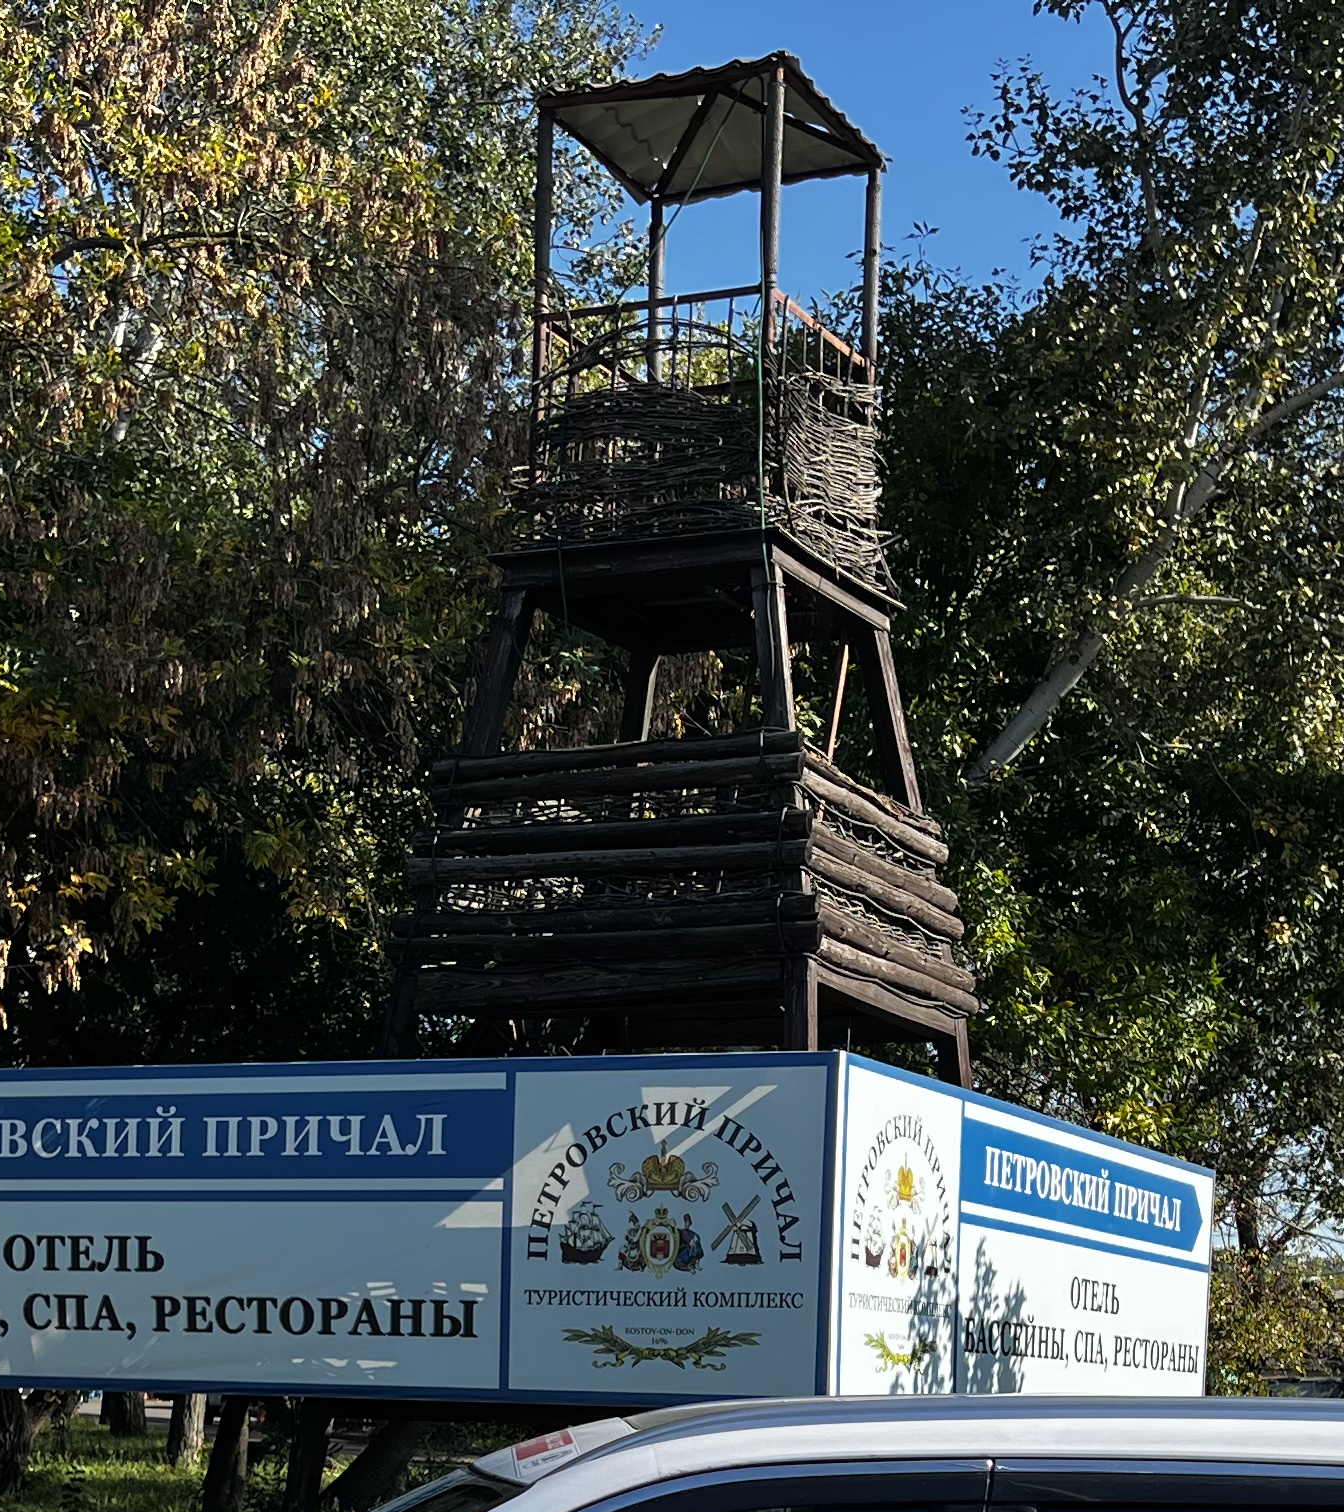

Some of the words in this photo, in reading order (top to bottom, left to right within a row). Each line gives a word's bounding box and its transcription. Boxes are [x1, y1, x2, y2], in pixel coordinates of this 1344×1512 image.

[202, 1113, 448, 1159] ПРИЧАЛ
[527, 1097, 711, 1262] ПЕТРОВСКИЙ
[712, 1114, 803, 1263] ПРИЧАЛ
[983, 1144, 1110, 1216] ПЕТРОВСКИЙ
[1113, 1184, 1183, 1233] ПРИЧАЛ
[2, 1233, 166, 1274] ОТЕЛЬ
[22, 1292, 137, 1341] СПА,
[151, 1294, 479, 1340] РЕСТОРАНЫ
[523, 1286, 688, 1309] ТУРИСТИЧЕСКИЙ
[693, 1290, 804, 1310] КОМПЛЕКС
[1069, 1275, 1121, 1316] ОТЕЛЬ
[963, 1314, 1070, 1370] БАССЕЙНЫ,
[1074, 1329, 1109, 1374] СПА,
[1113, 1335, 1200, 1376] РЕСТОРАНЫ
